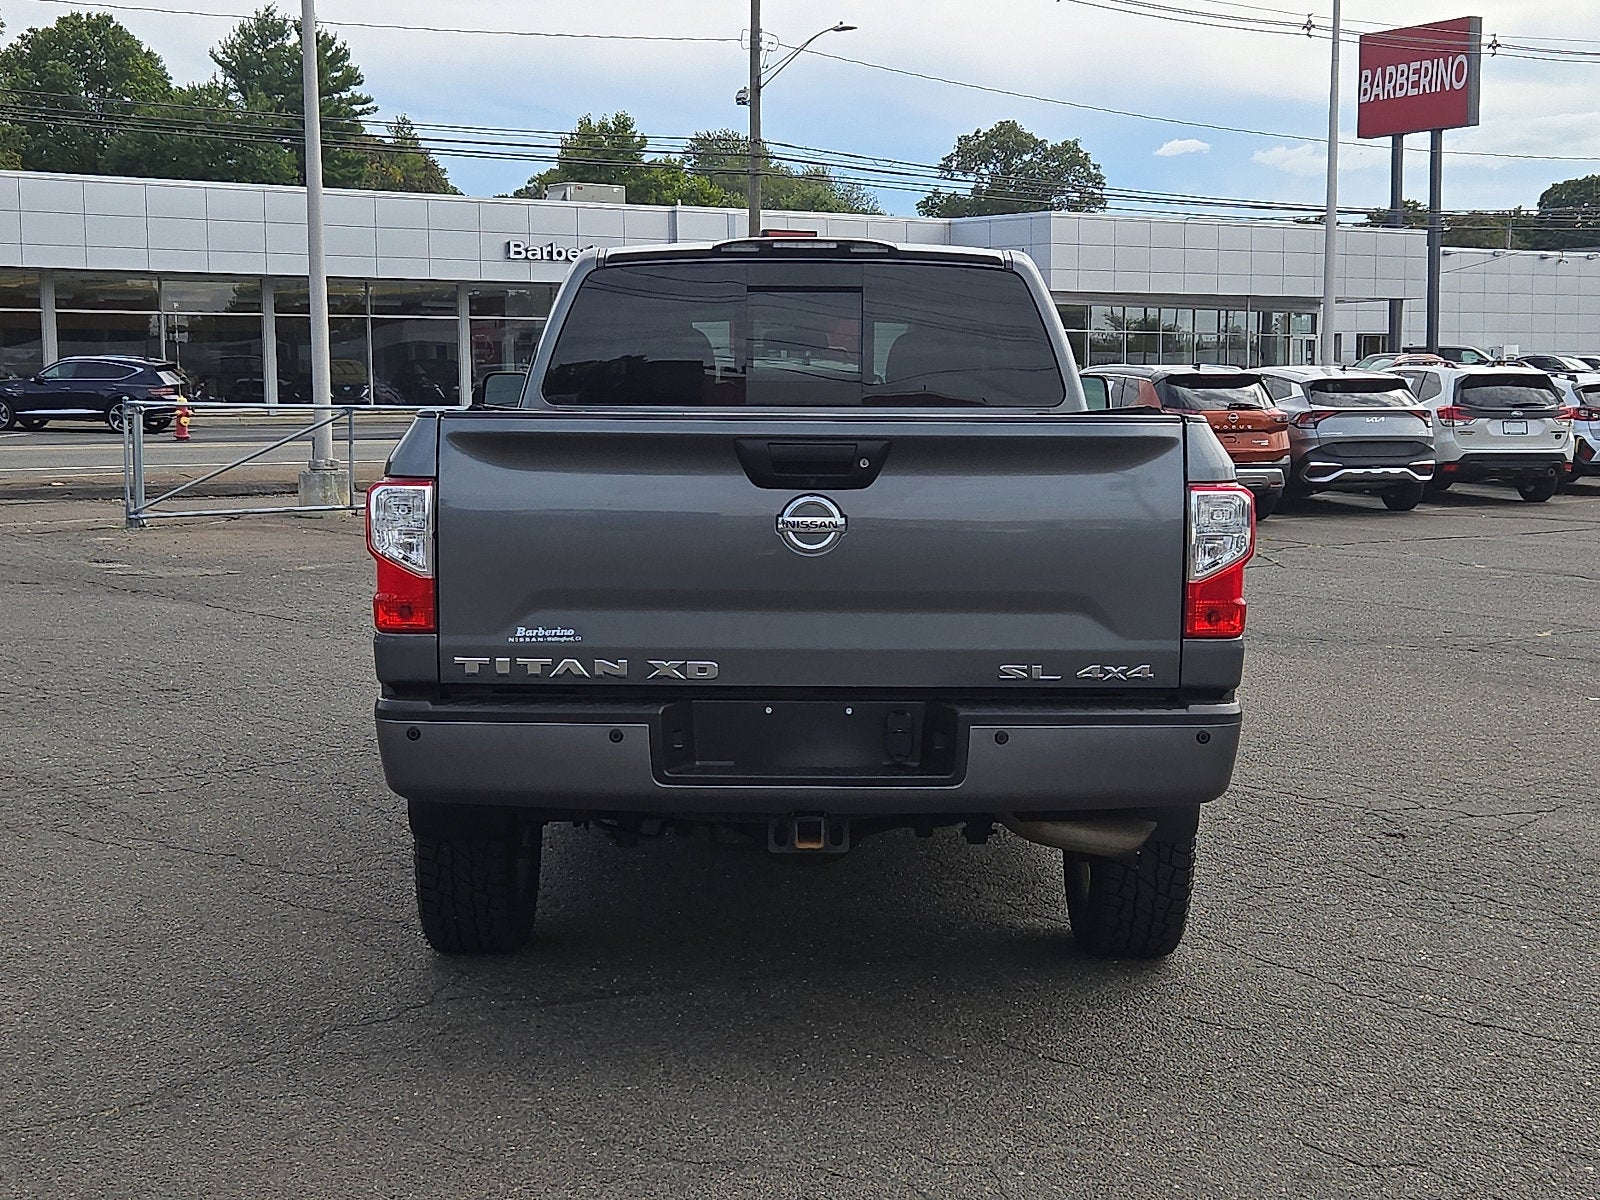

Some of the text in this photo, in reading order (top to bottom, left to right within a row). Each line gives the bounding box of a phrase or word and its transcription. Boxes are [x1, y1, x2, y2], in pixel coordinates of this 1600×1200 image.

[1359, 54, 1468, 104] BARBERINO
[505, 240, 583, 263] Barbe
[784, 520, 838, 529] NISSAN
[515, 626, 575, 637] Barberino
[453, 656, 719, 680] TITAN XD
[998, 664, 1062, 680] SL
